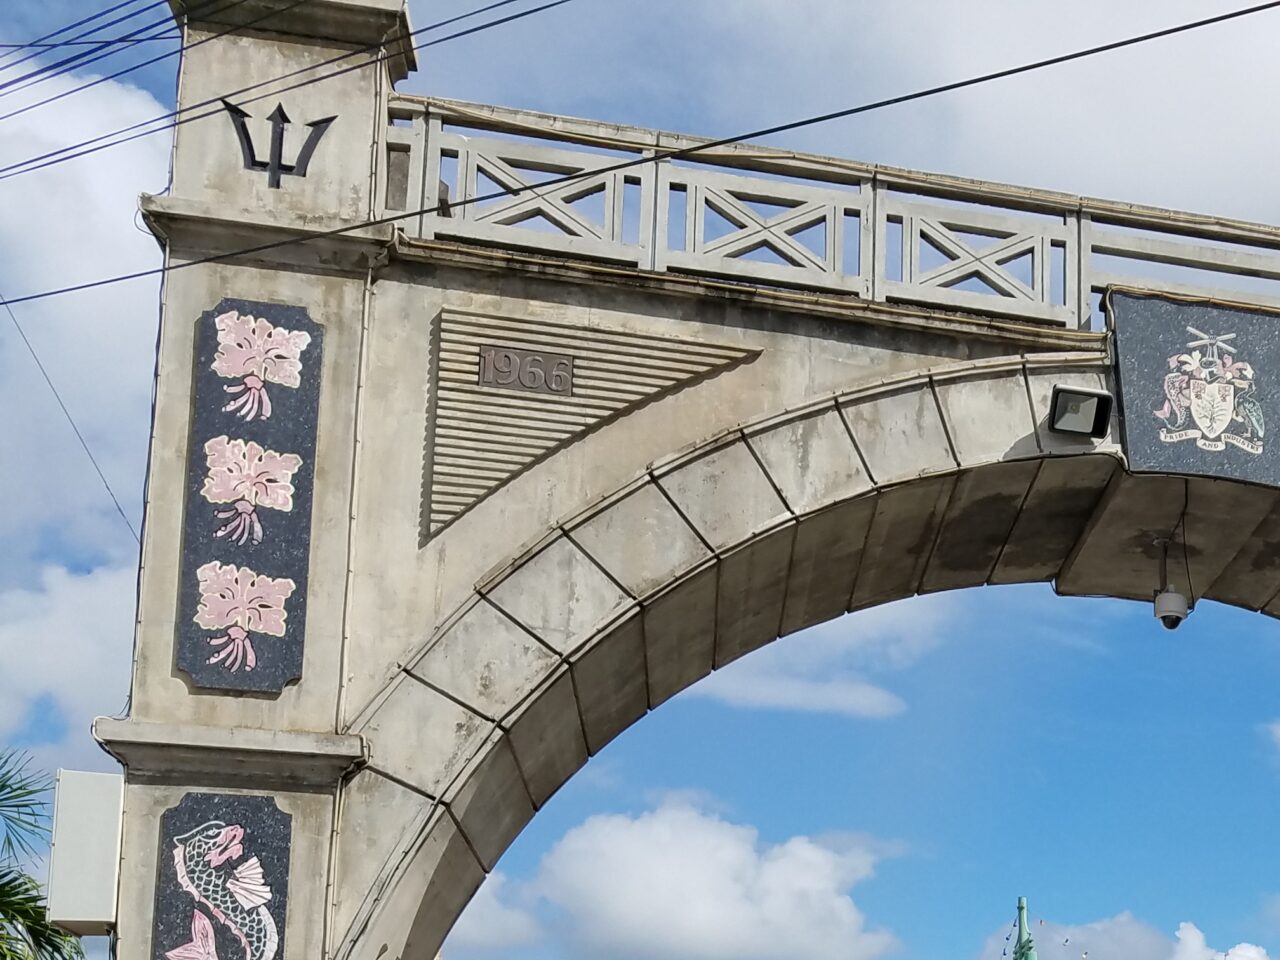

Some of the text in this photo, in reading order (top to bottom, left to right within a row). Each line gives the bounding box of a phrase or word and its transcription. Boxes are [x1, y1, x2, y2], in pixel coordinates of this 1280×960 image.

[482, 350, 571, 392] 1966
[1164, 431, 1260, 453] PRIDE AND INDUSTRY
